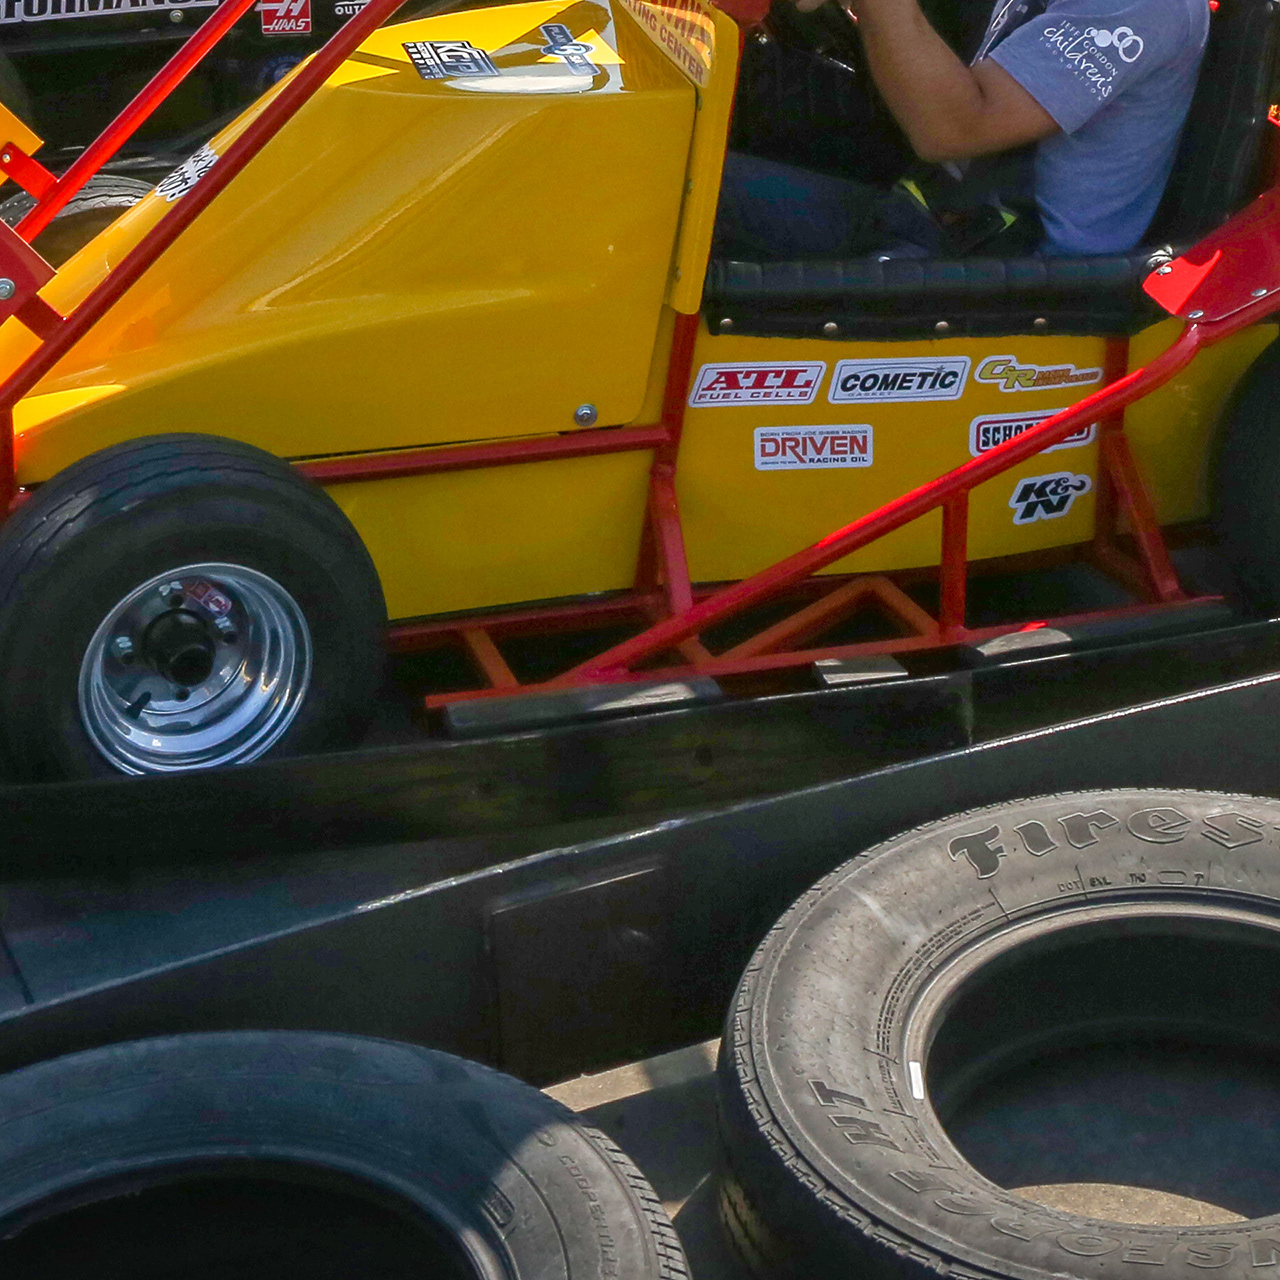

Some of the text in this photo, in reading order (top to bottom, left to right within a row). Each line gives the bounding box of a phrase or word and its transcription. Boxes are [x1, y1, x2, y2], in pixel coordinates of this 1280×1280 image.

[269, 18, 306, 31] HAAS
[548, 26, 569, 44] PLAN
[431, 42, 476, 75] KCP
[660, 25, 704, 85] CENTER
[1043, 26, 1114, 98] children's
[1060, 20, 1119, 77] JEFF GORDON
[701, 369, 815, 392] ATL
[840, 367, 959, 394] COMETIC
[698, 391, 809, 401] FUEL CELLS
[760, 435, 868, 464] DRIVEN
[808, 455, 868, 464] RACING OIL
[807, 1078, 905, 1155] HT
